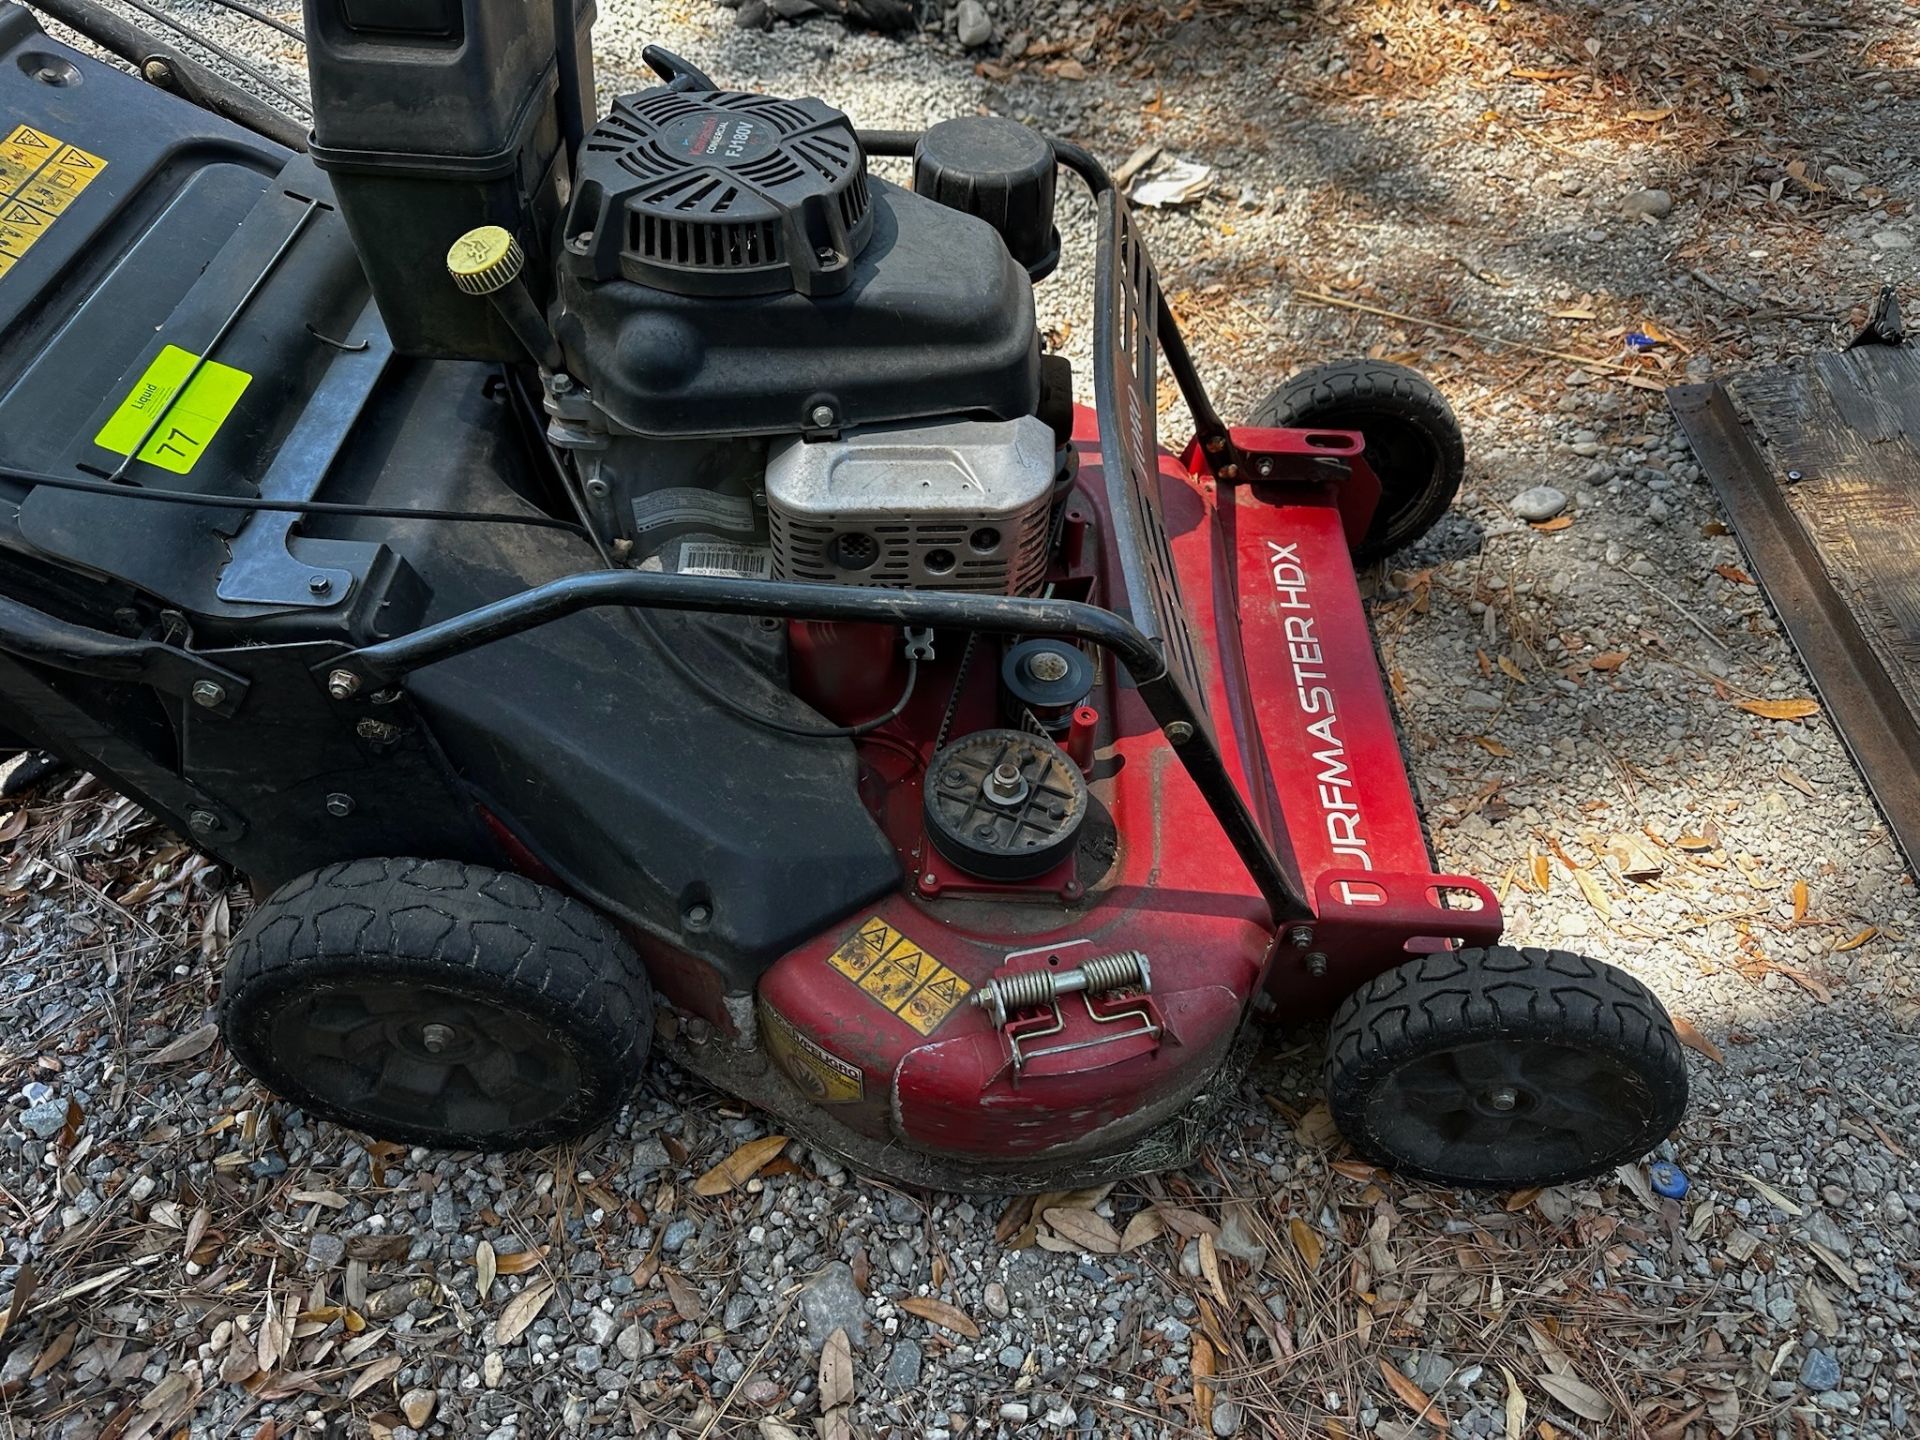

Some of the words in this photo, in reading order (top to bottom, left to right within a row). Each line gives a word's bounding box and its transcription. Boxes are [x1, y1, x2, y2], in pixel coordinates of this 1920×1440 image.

[706, 121, 729, 154] COMMERCIAL
[725, 121, 754, 157] FJ180V
[131, 383, 158, 410] Liquid
[155, 427, 200, 458] 77
[1269, 541, 1311, 610] HDX
